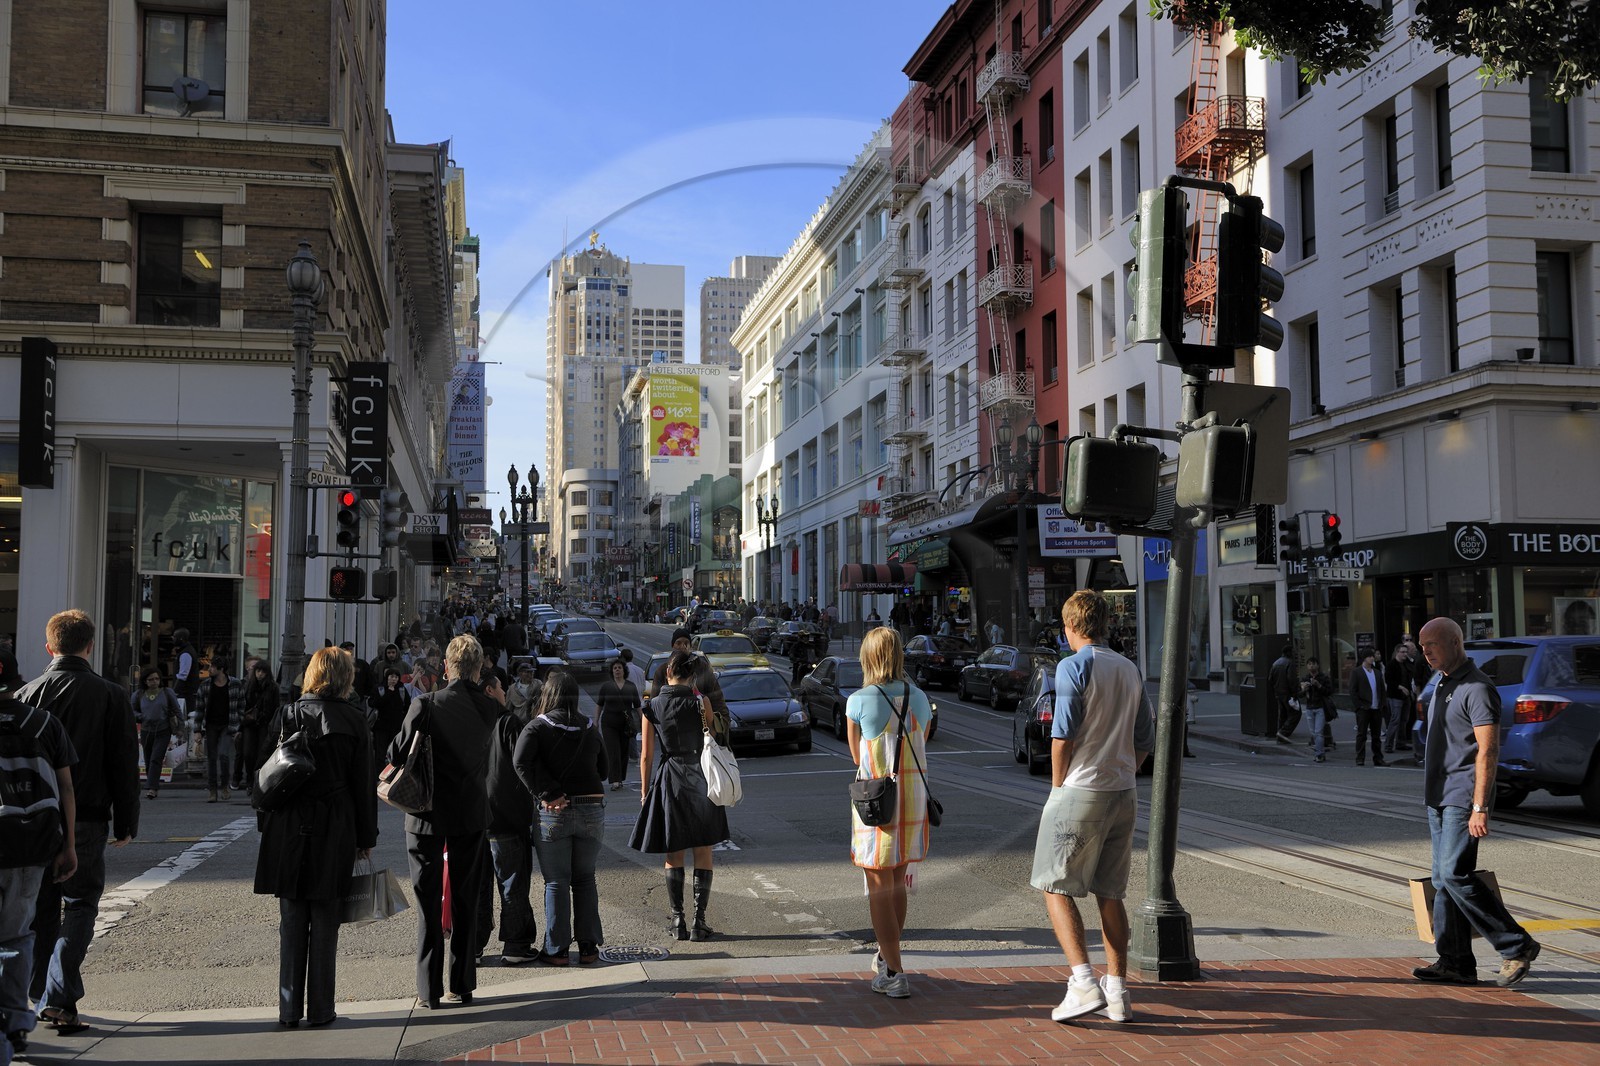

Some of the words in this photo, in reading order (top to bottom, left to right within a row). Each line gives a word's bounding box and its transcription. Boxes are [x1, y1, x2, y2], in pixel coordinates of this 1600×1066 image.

[677, 367, 720, 375] STRATFORD
[652, 385, 694, 393] twittering
[459, 450, 473, 458] THE
[413, 514, 440, 525] DSW
[152, 532, 230, 561] fcuk
[1090, 539, 1106, 547] Sports
[1225, 539, 1240, 549] PARIS
[1508, 533, 1552, 552] THE
[1559, 534, 1600, 553] BOD
[605, 547, 630, 555] HOTE
[1343, 550, 1374, 568] SHOP
[1323, 569, 1360, 579] ELLIS
